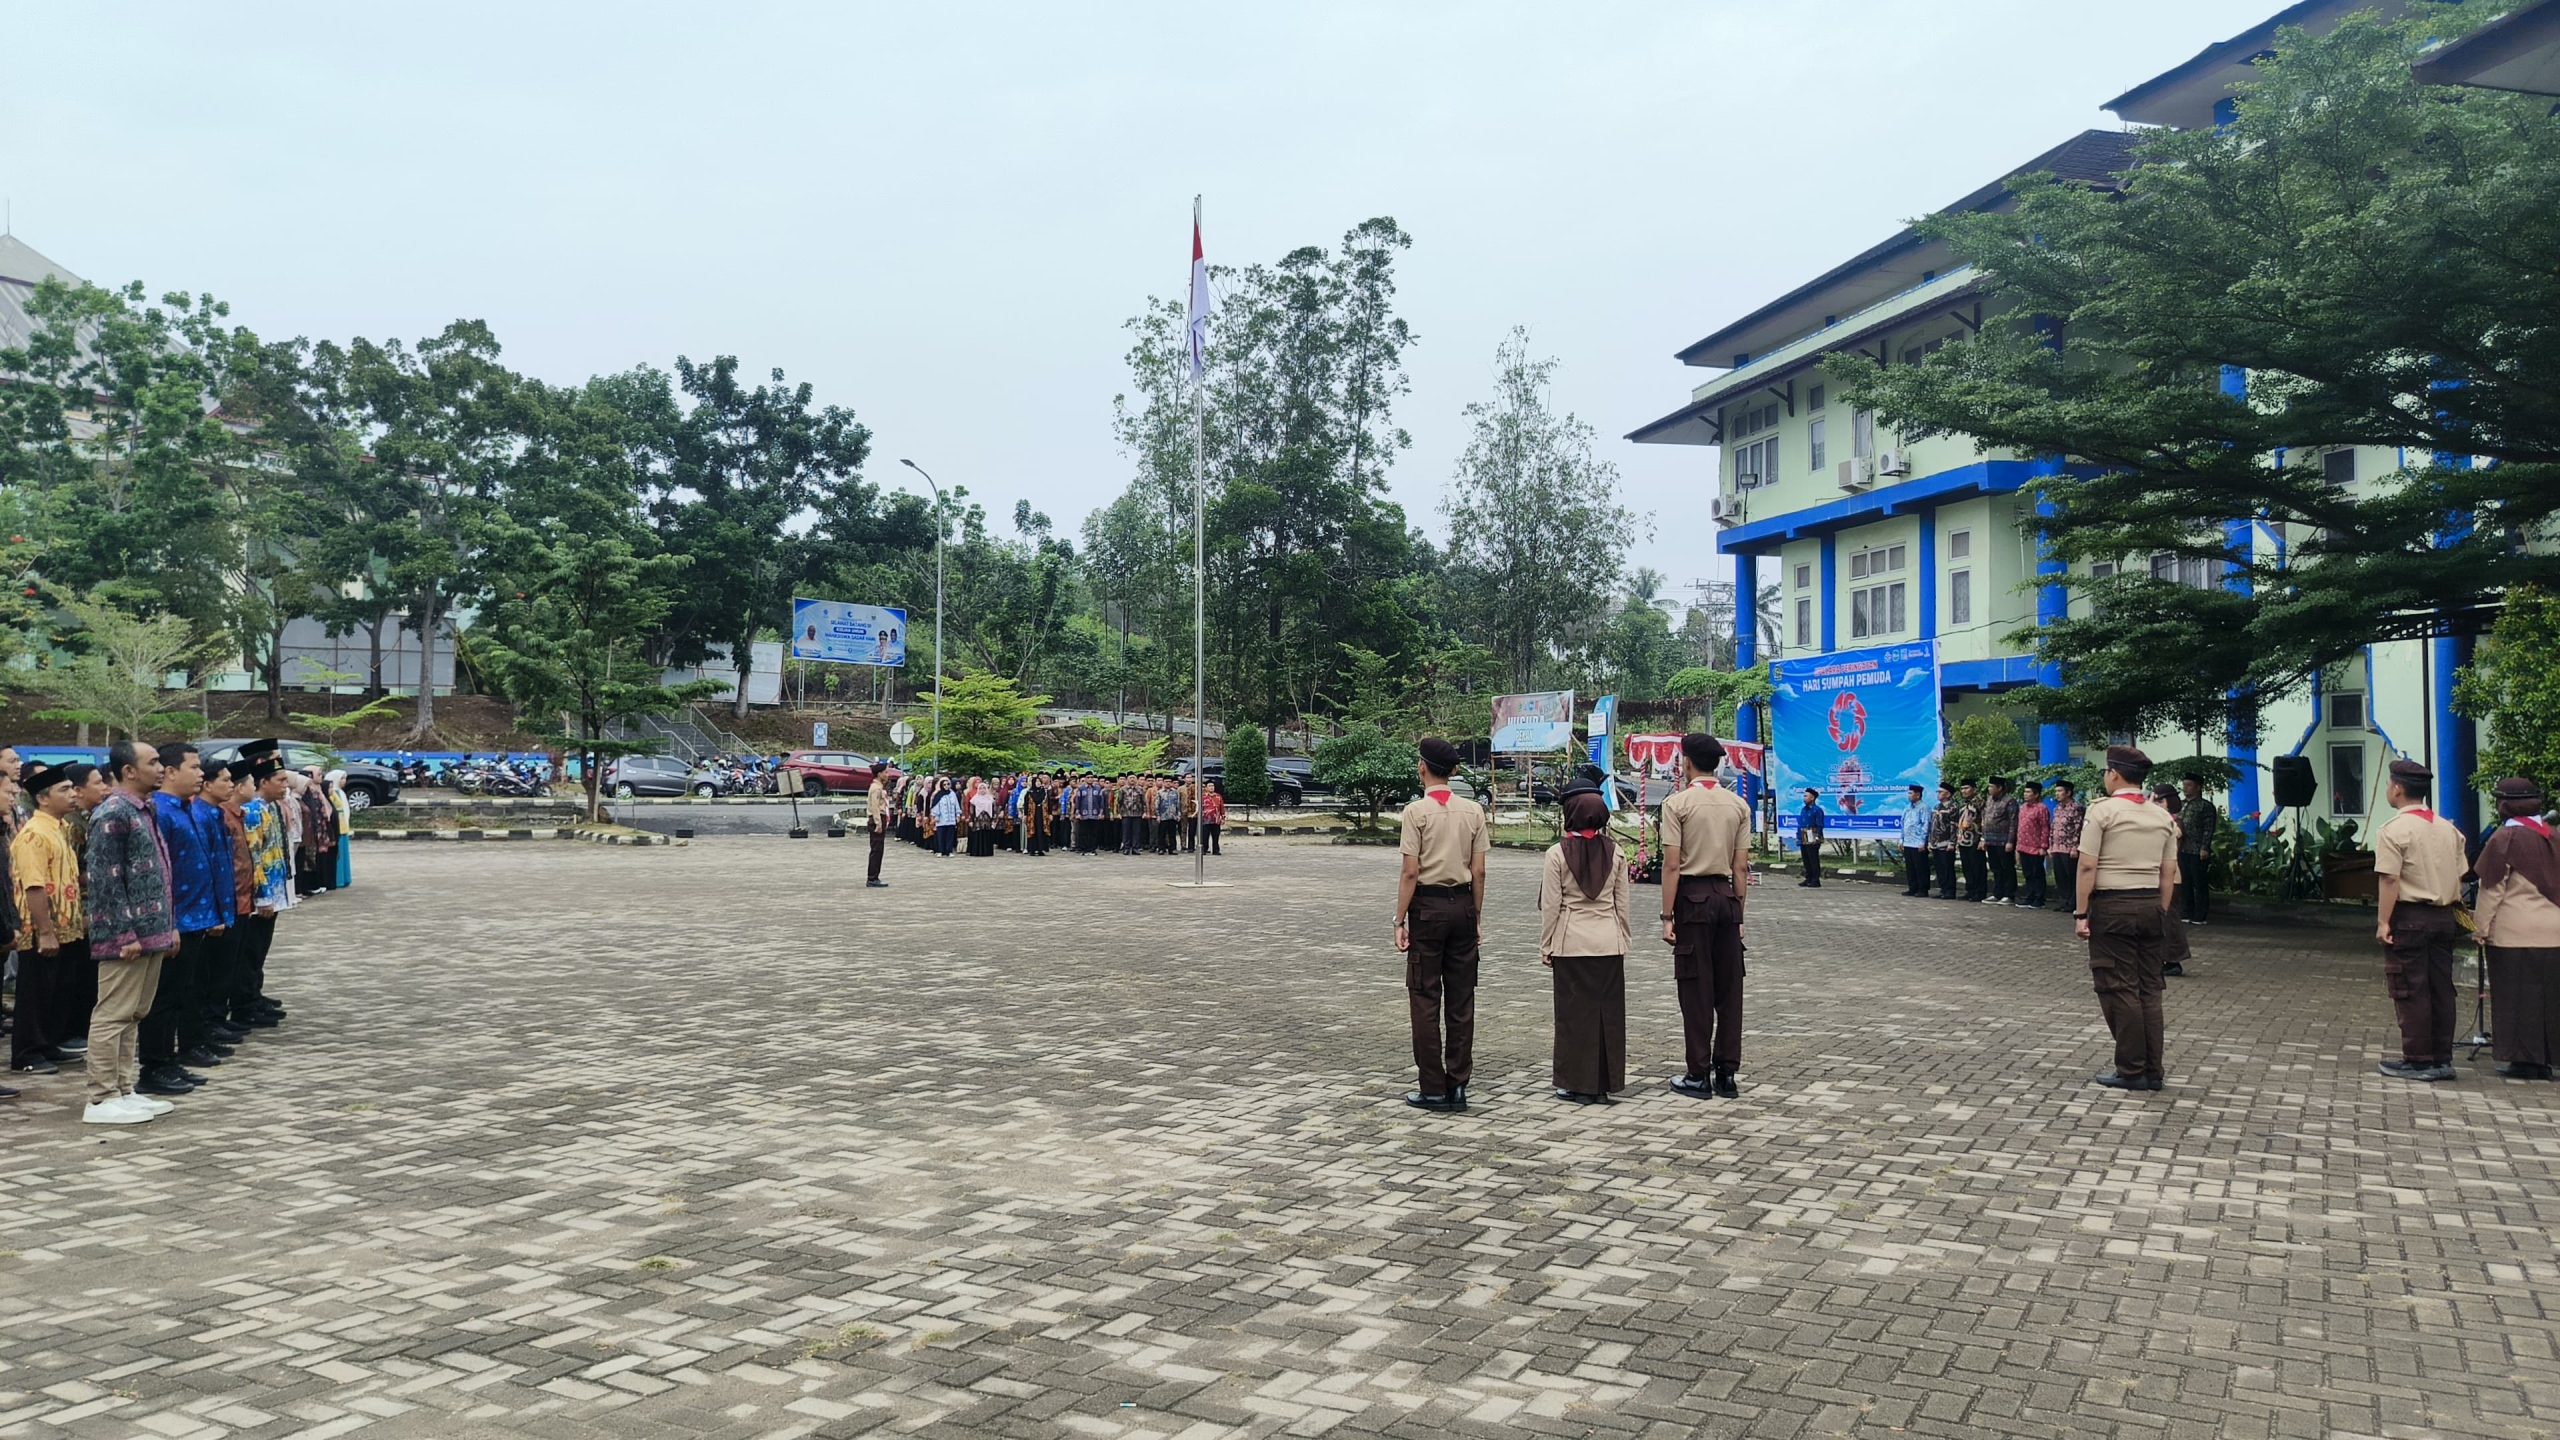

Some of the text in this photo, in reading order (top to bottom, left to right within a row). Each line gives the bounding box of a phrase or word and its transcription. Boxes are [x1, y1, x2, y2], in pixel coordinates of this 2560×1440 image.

[1802, 670, 1891, 692] HARI SUMPAH PEMUDA
